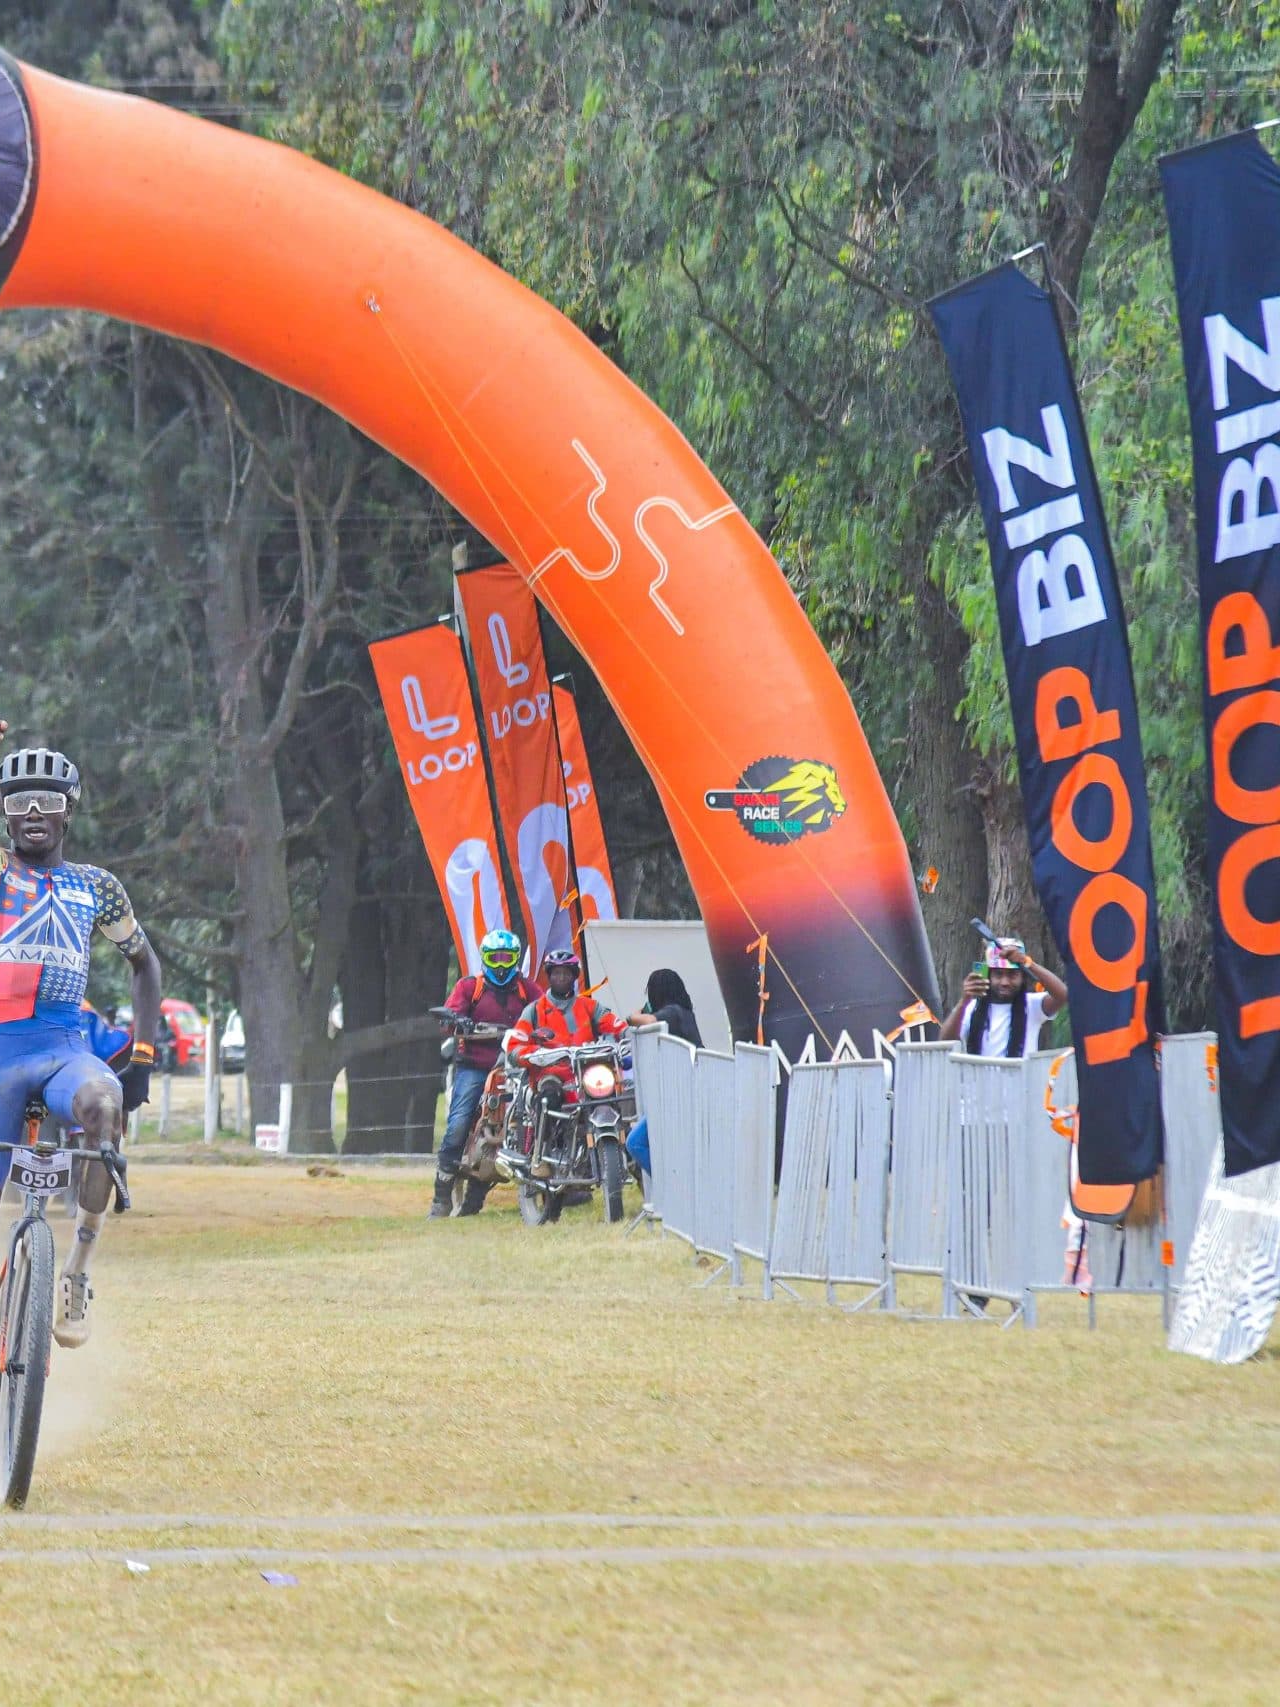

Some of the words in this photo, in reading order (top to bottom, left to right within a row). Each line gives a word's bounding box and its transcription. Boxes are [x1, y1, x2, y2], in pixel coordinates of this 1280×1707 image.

[982, 403, 1108, 647] BIZ
[490, 693, 550, 740] LOOP
[406, 742, 477, 786] LOOP
[566, 783, 591, 808] OP
[743, 806, 780, 820] RACE
[1034, 665, 1149, 1066] LOOP
[21, 1170, 59, 1188] 050
